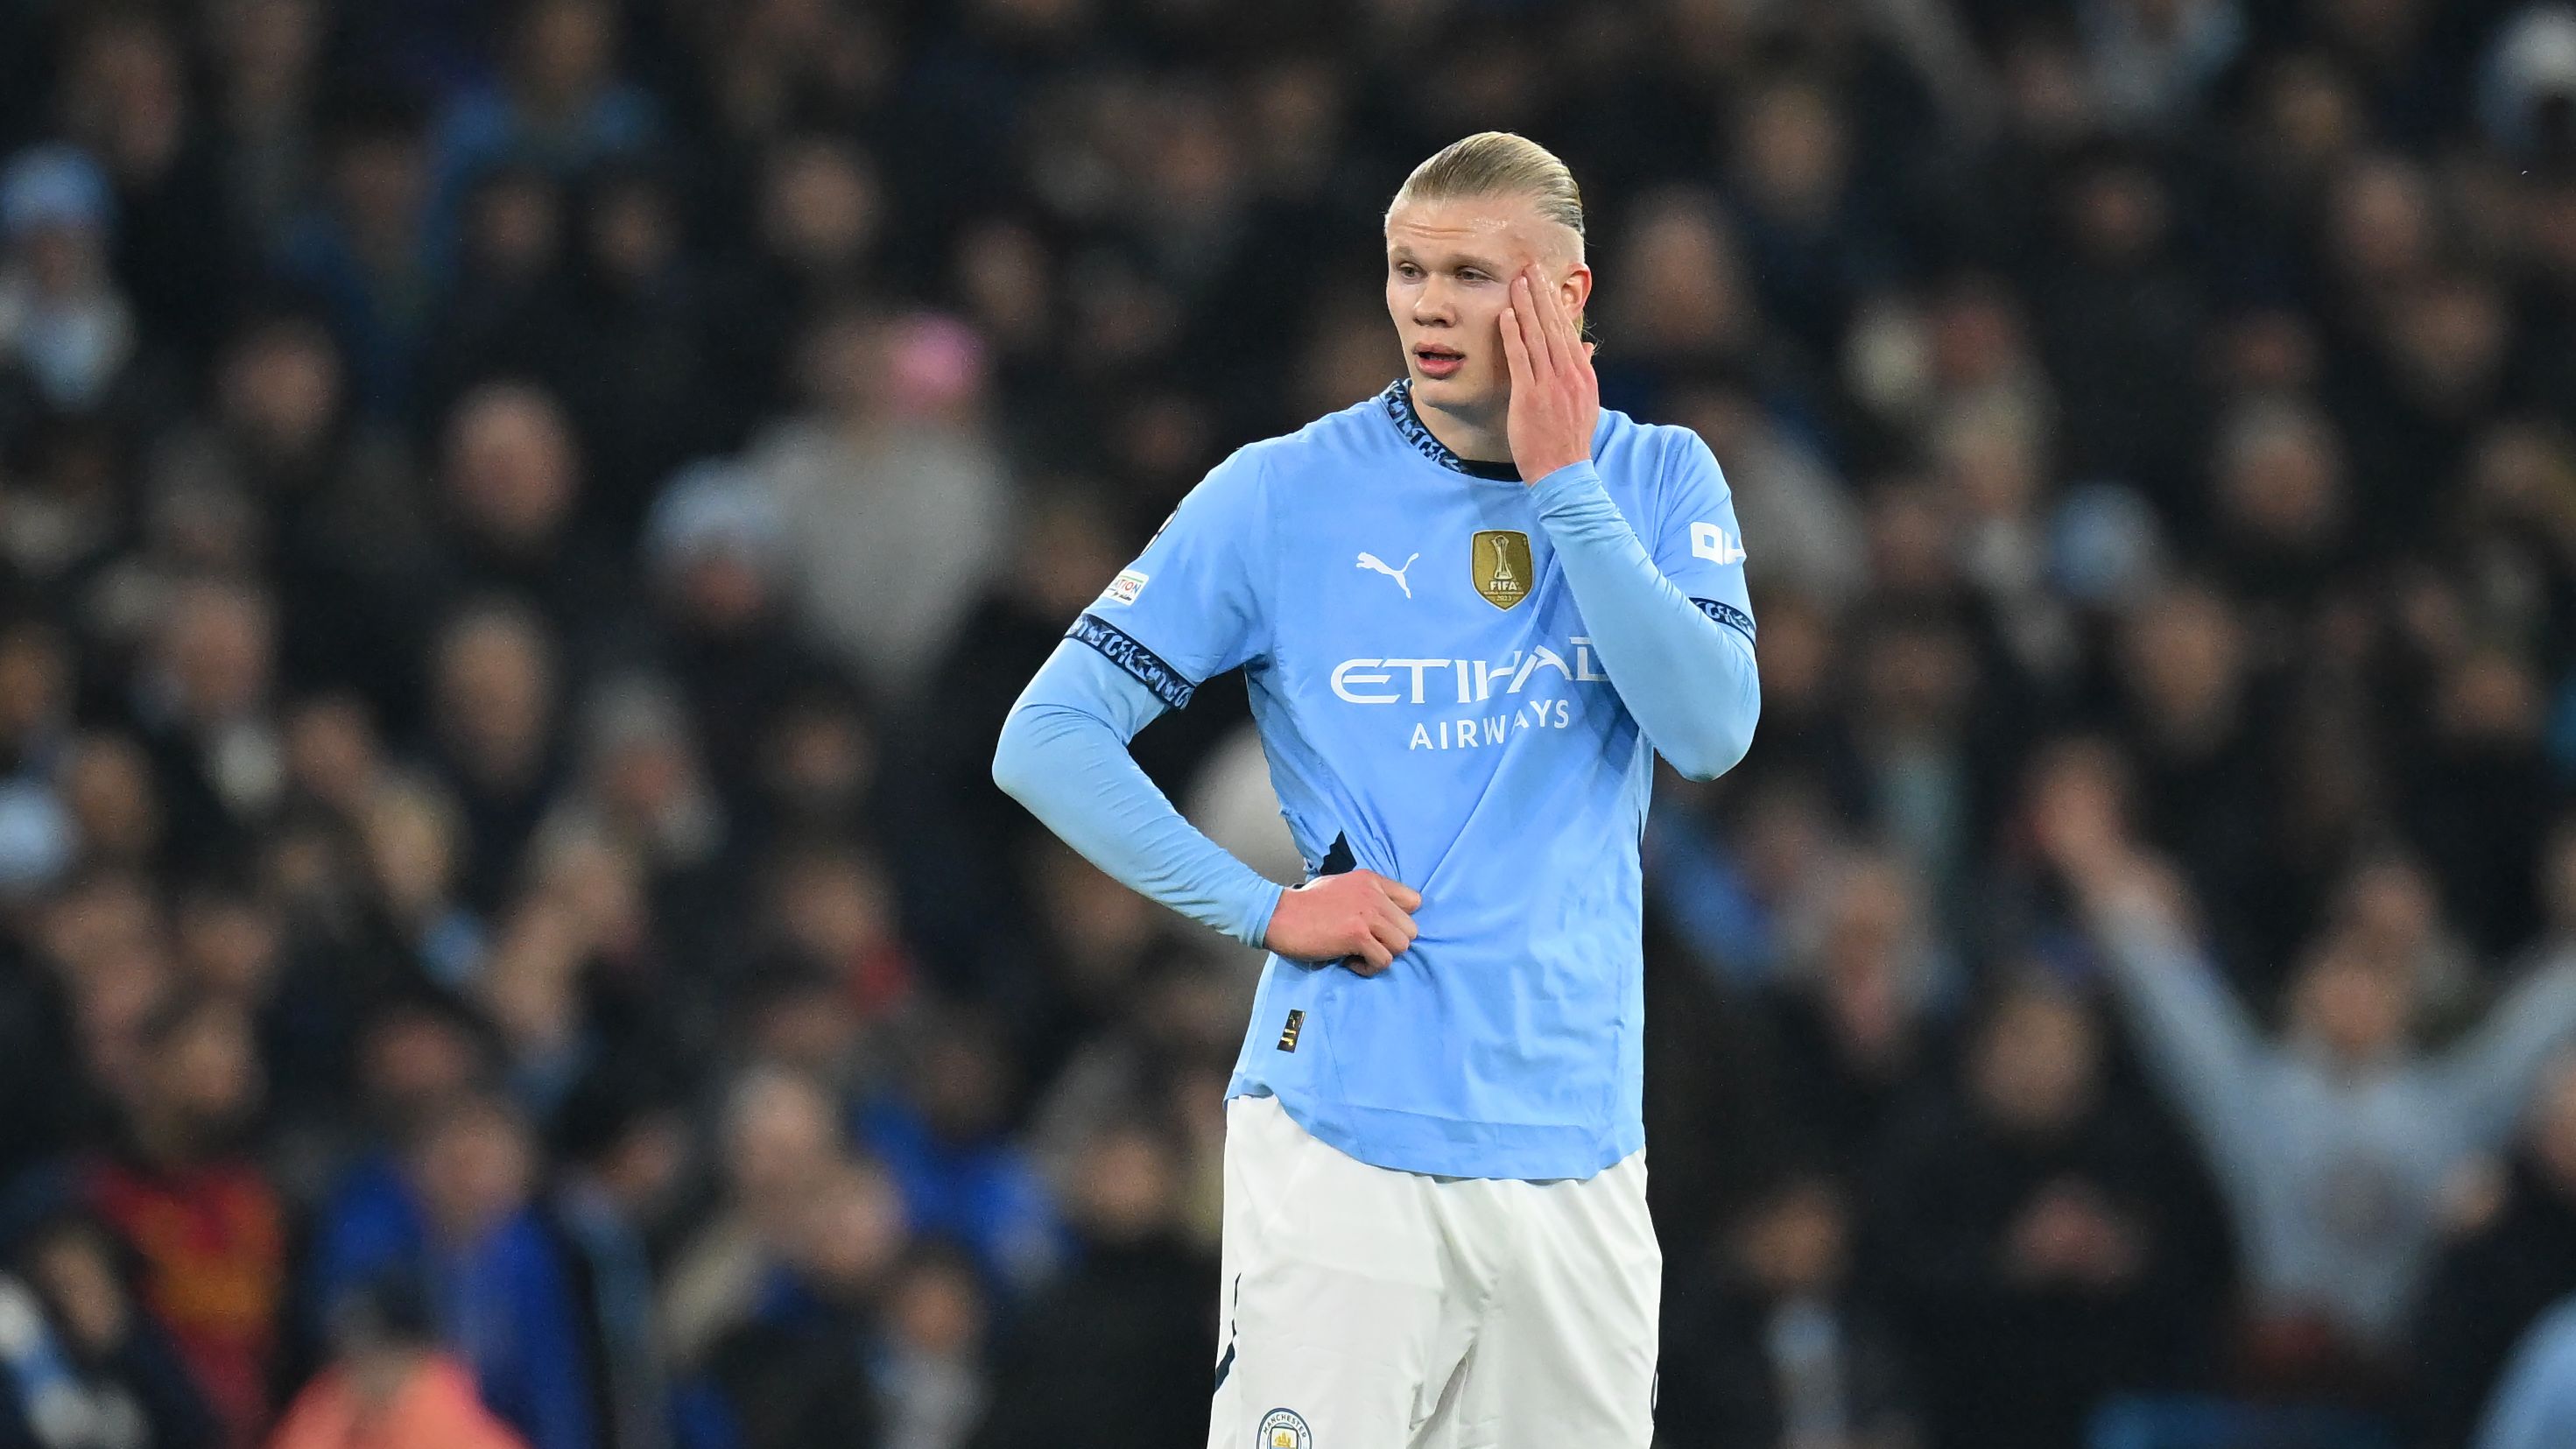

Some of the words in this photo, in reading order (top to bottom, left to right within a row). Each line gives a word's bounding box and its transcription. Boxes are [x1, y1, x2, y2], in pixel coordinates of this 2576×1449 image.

[1489, 580, 1518, 591] FIFA
[1409, 699, 1570, 750] AIRWAYS
[1263, 1413, 1307, 1438] MANCHESTER
